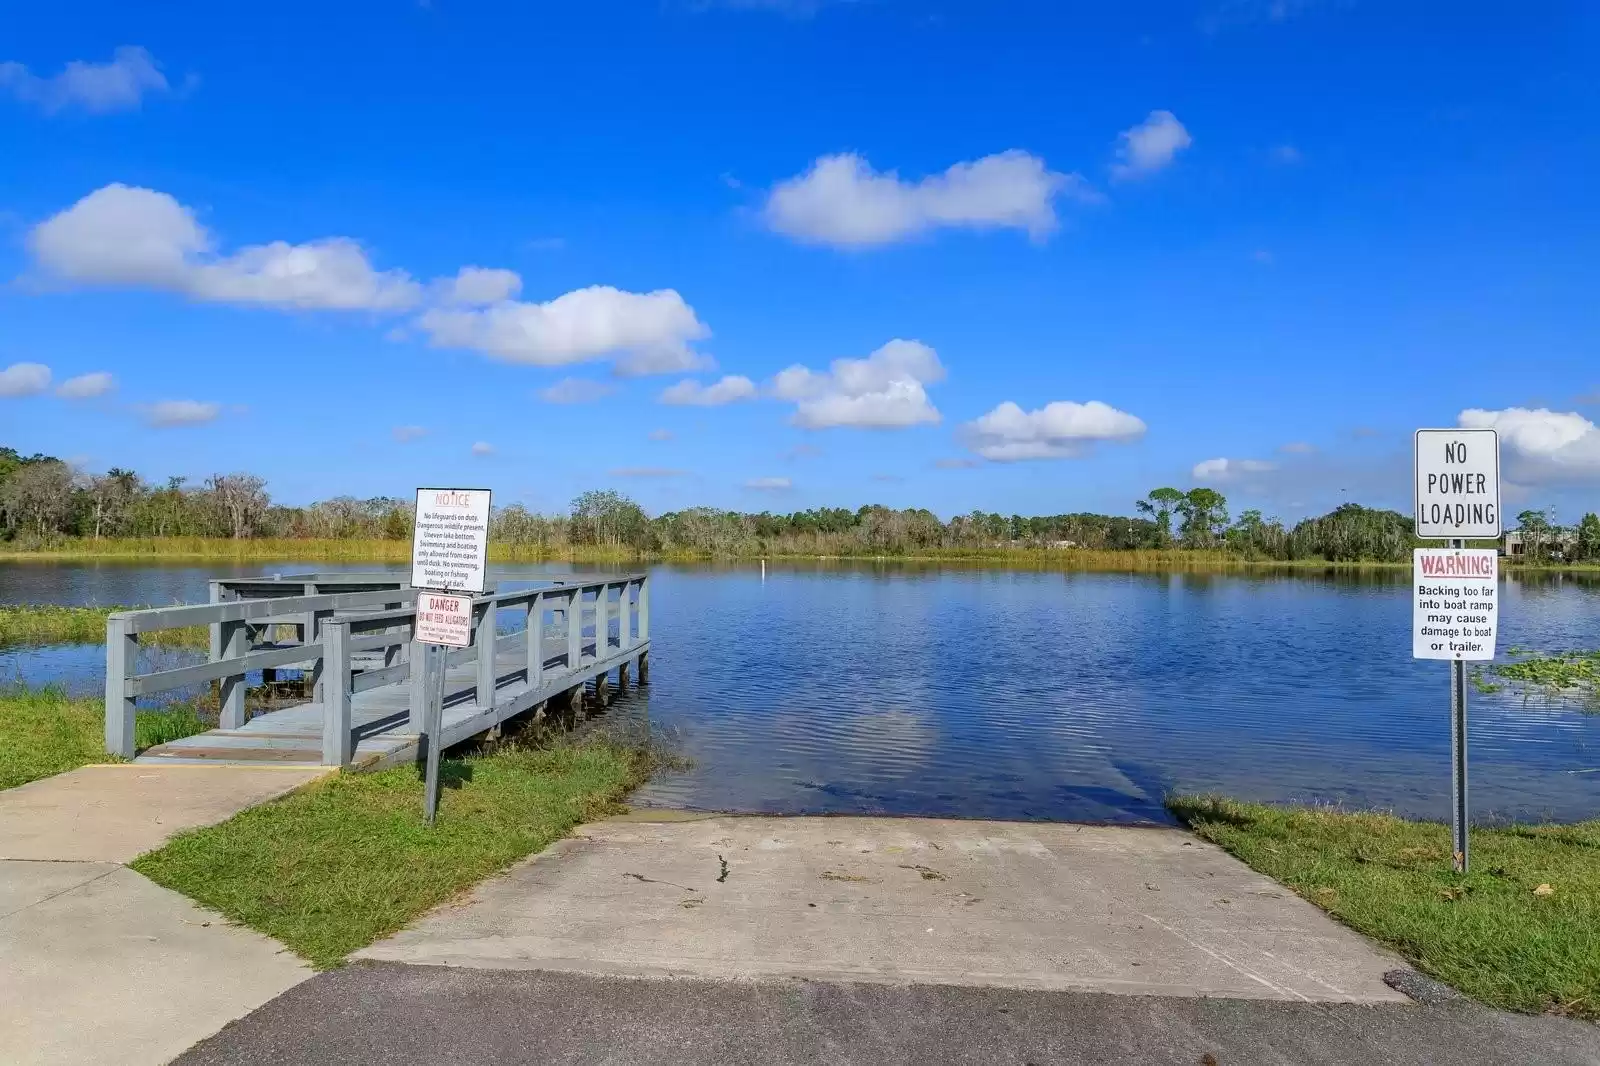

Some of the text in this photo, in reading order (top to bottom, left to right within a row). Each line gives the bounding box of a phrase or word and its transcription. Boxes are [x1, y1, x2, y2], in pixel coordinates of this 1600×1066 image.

[1446, 443, 1467, 464] NO
[1428, 473, 1486, 494] POWER
[435, 493, 470, 507] NOTICE
[432, 513, 457, 522] lifeguards
[1421, 504, 1495, 524] LOADING
[417, 522, 443, 531] Dangerous
[420, 540, 446, 550] Swimming
[457, 542, 478, 552] boating
[418, 550, 478, 560] only allowed from dawn
[1421, 556, 1493, 575] WARNING!
[424, 569, 444, 578] boating
[450, 570, 469, 580] fishing
[1419, 586, 1494, 597] Backing too far
[430, 598, 459, 612] DANGER
[1419, 599, 1494, 611] into boat ramp
[435, 613, 444, 623] FEED
[1427, 614, 1487, 624] may cause
[1421, 626, 1492, 638] damage to boat
[1431, 641, 1484, 651] or trailer.
